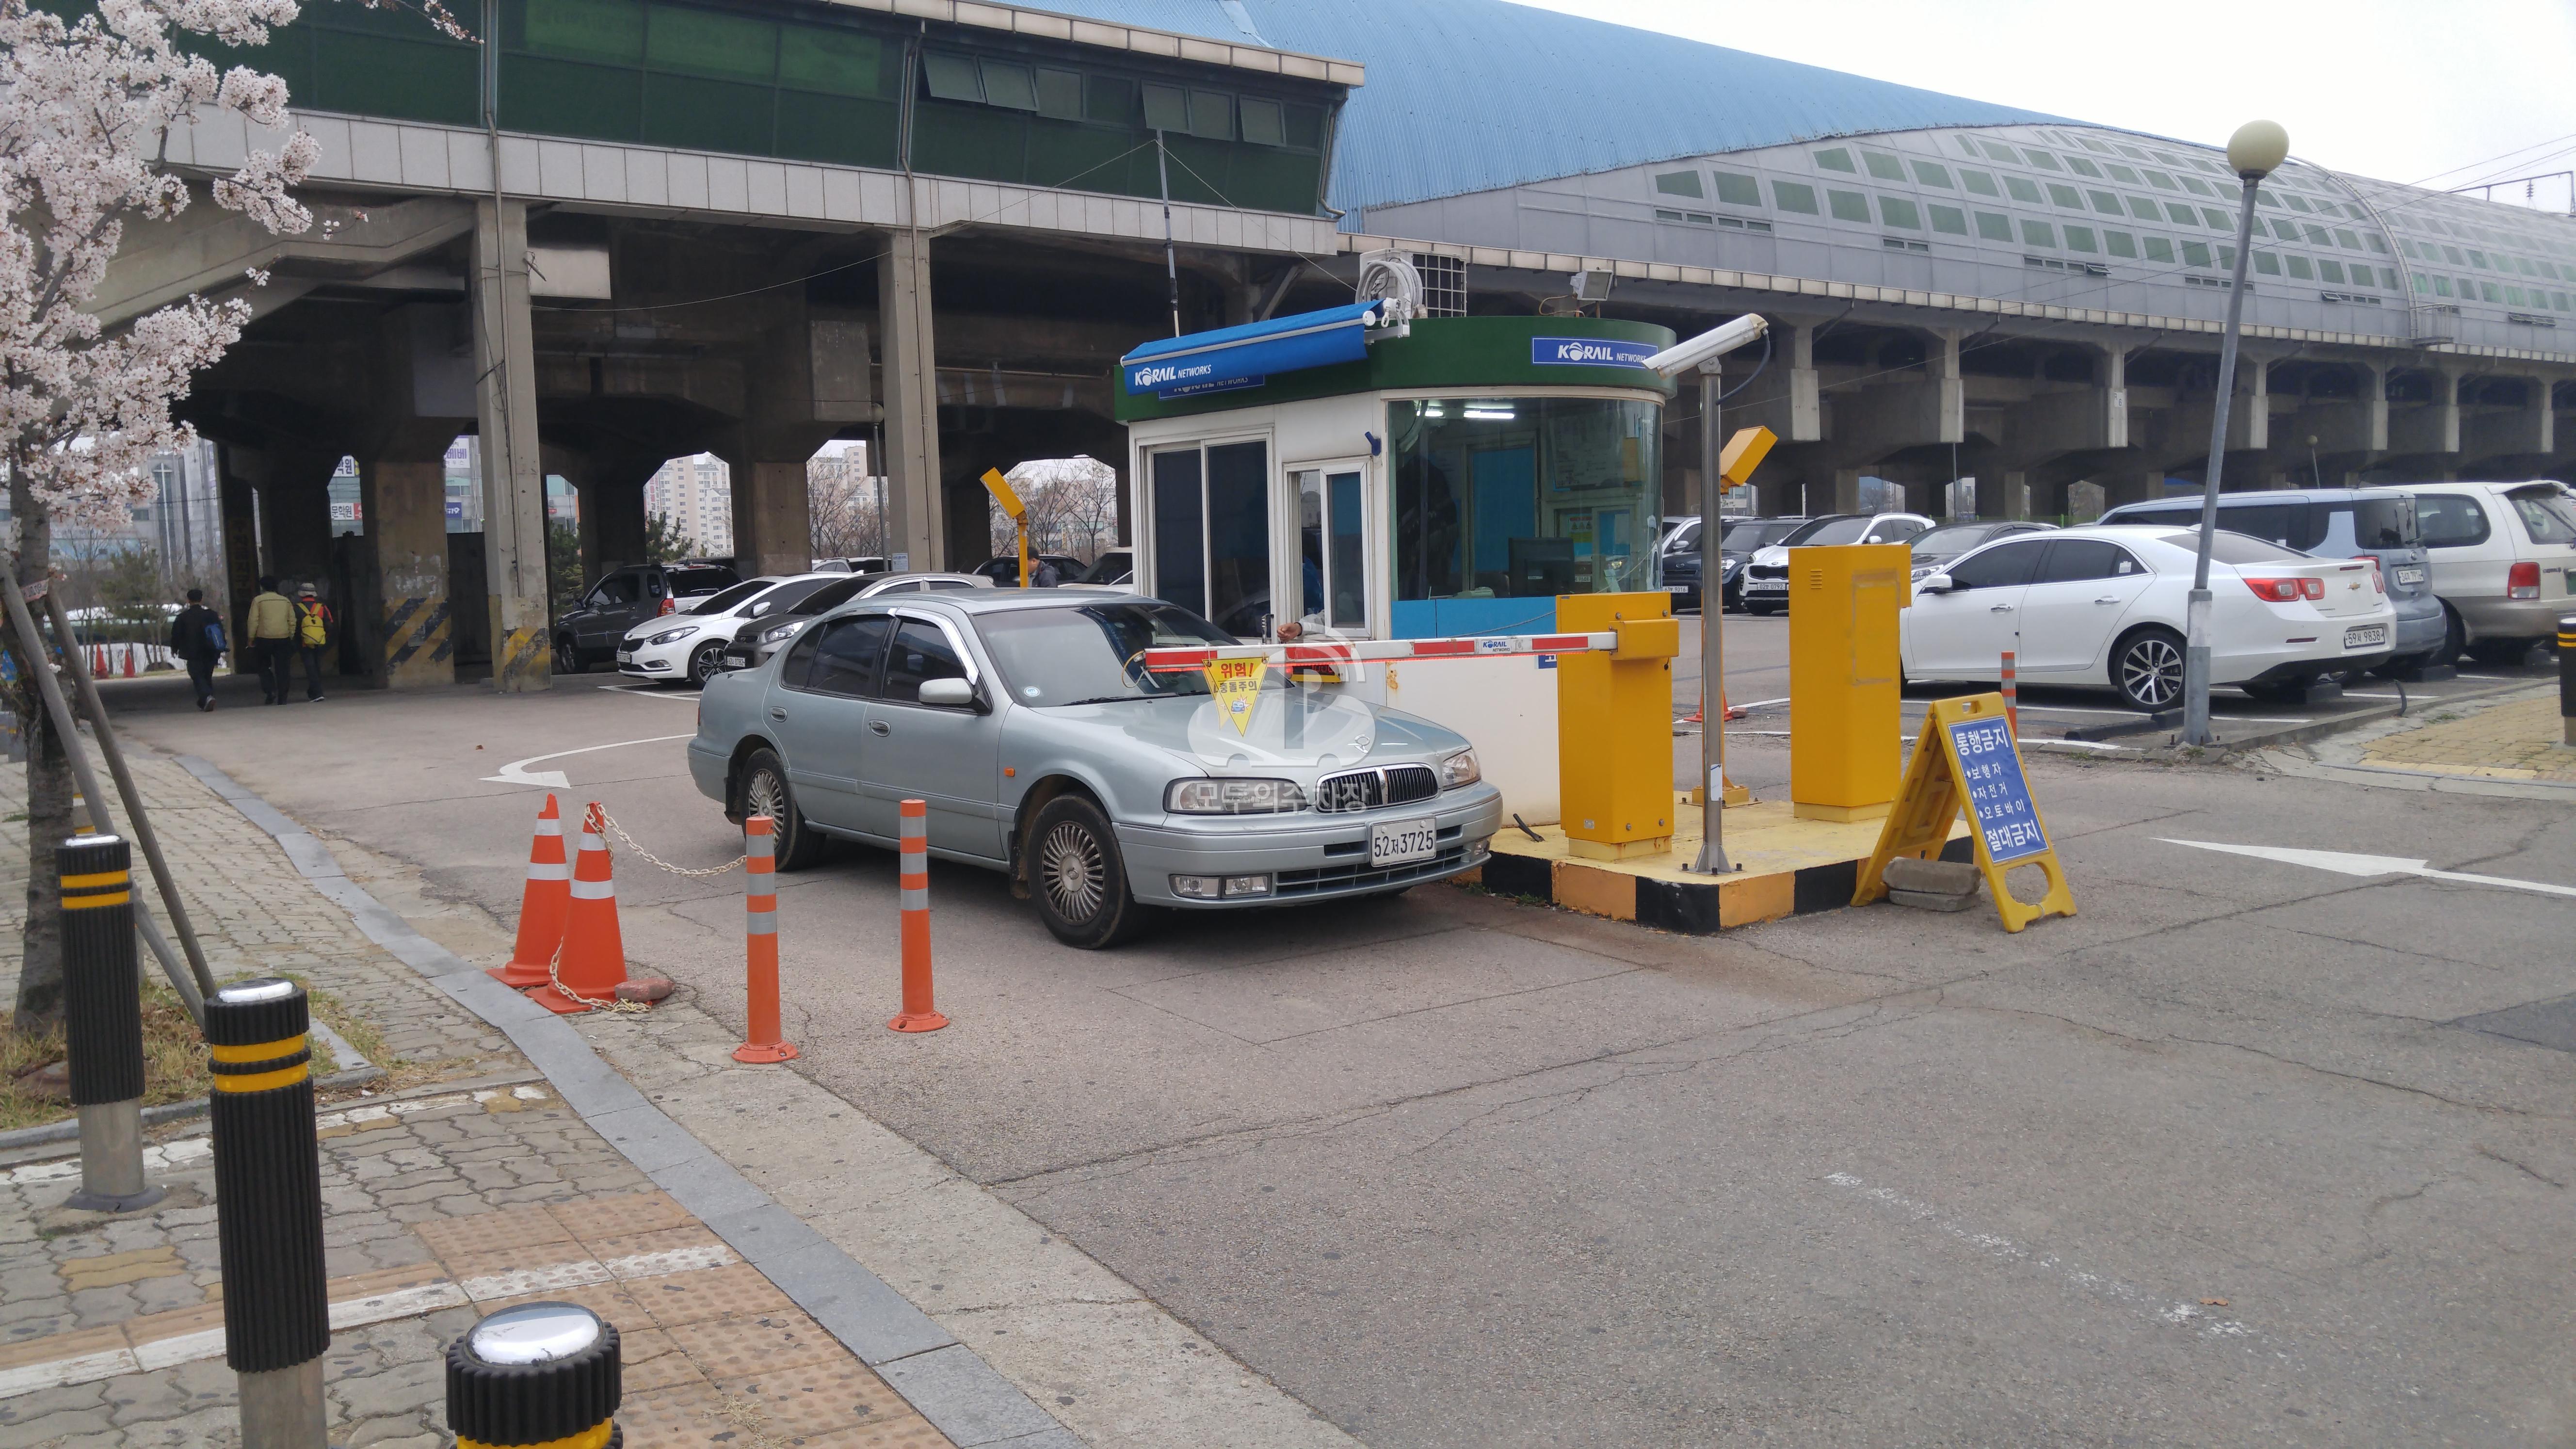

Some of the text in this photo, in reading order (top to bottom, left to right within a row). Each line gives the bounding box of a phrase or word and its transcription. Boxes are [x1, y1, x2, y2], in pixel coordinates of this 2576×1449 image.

[1558, 342, 1646, 363] KORAIL NETWORKS
[1135, 364, 1212, 386] KORAIL NETWORKS
[2364, 630, 2381, 642] 9838
[1221, 662, 1254, 678] 위험!
[1220, 680, 1257, 693] 충돌주의
[1956, 726, 2009, 756] 통행금지
[1374, 830, 1433, 857] 52저3725
[1986, 820, 2041, 852] 절대금지
